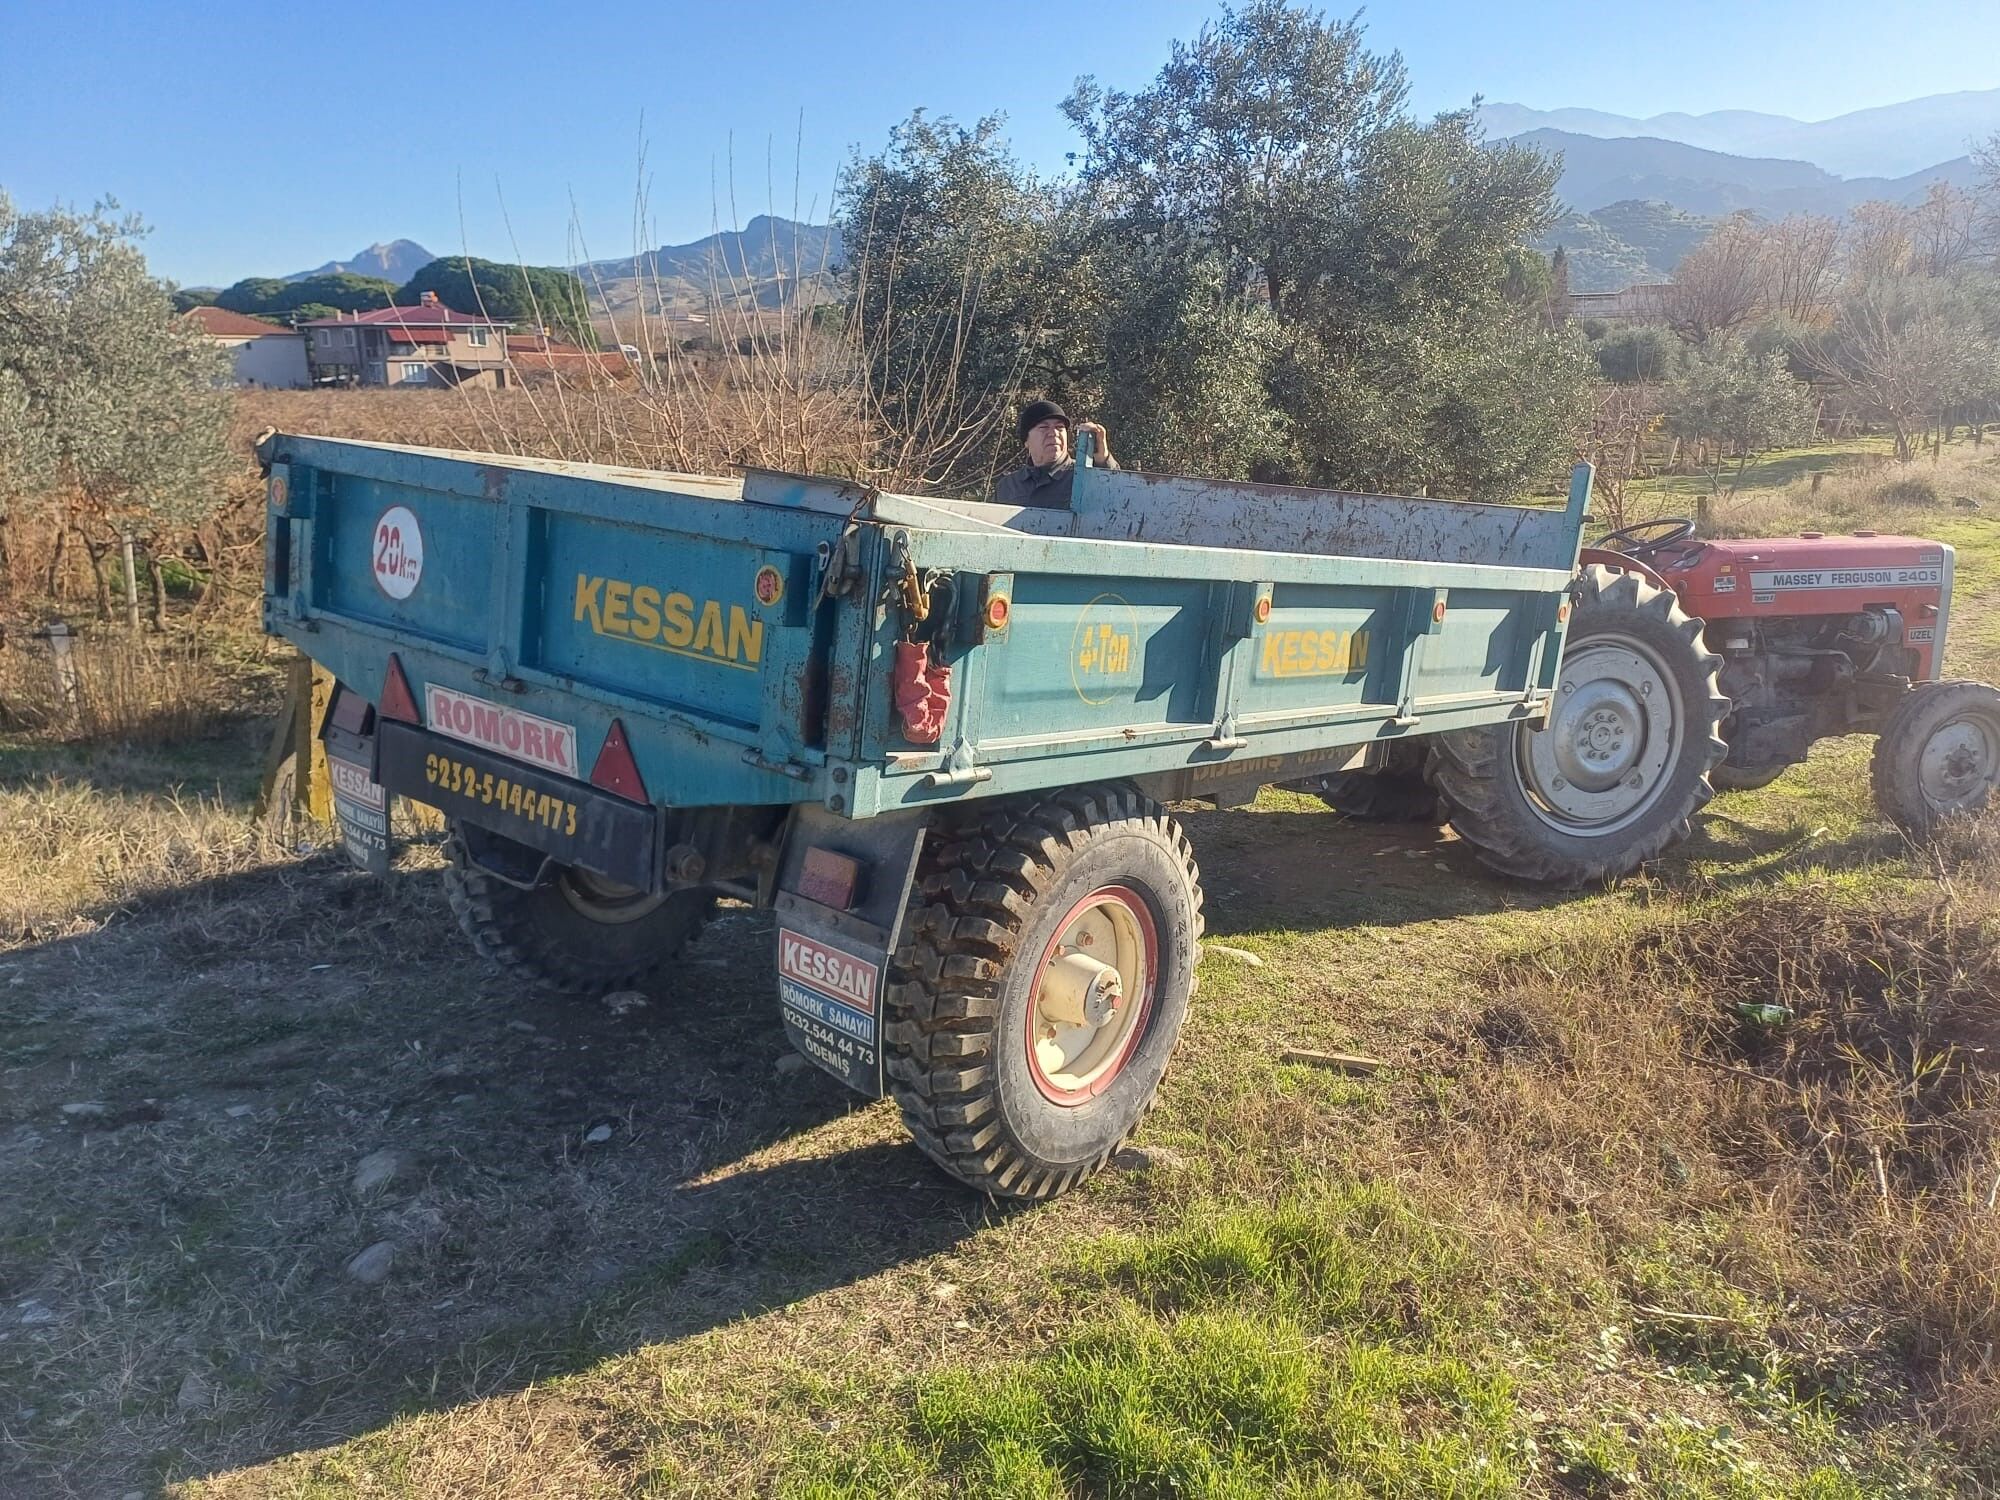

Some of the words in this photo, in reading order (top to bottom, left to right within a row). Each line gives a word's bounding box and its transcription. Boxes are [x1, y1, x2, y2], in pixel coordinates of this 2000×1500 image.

[1773, 573, 1822, 587] MASSEY
[1831, 572, 1891, 585] FERGUSON
[574, 573, 764, 665] KESSAN
[1910, 629, 1932, 640] UZEL
[1261, 630, 1370, 675] KESSAN
[331, 761, 381, 801] KESSAN
[426, 753, 577, 836] 0232-5444473
[373, 837, 386, 851] 73
[784, 938, 871, 1001] KESSAN
[782, 983, 824, 1018] RÖMORK
[783, 1007, 835, 1047] 0232.544
[837, 1038, 854, 1056] 44
[857, 1045, 874, 1066] 73
[805, 1036, 850, 1077] ÖDEMİŞ
